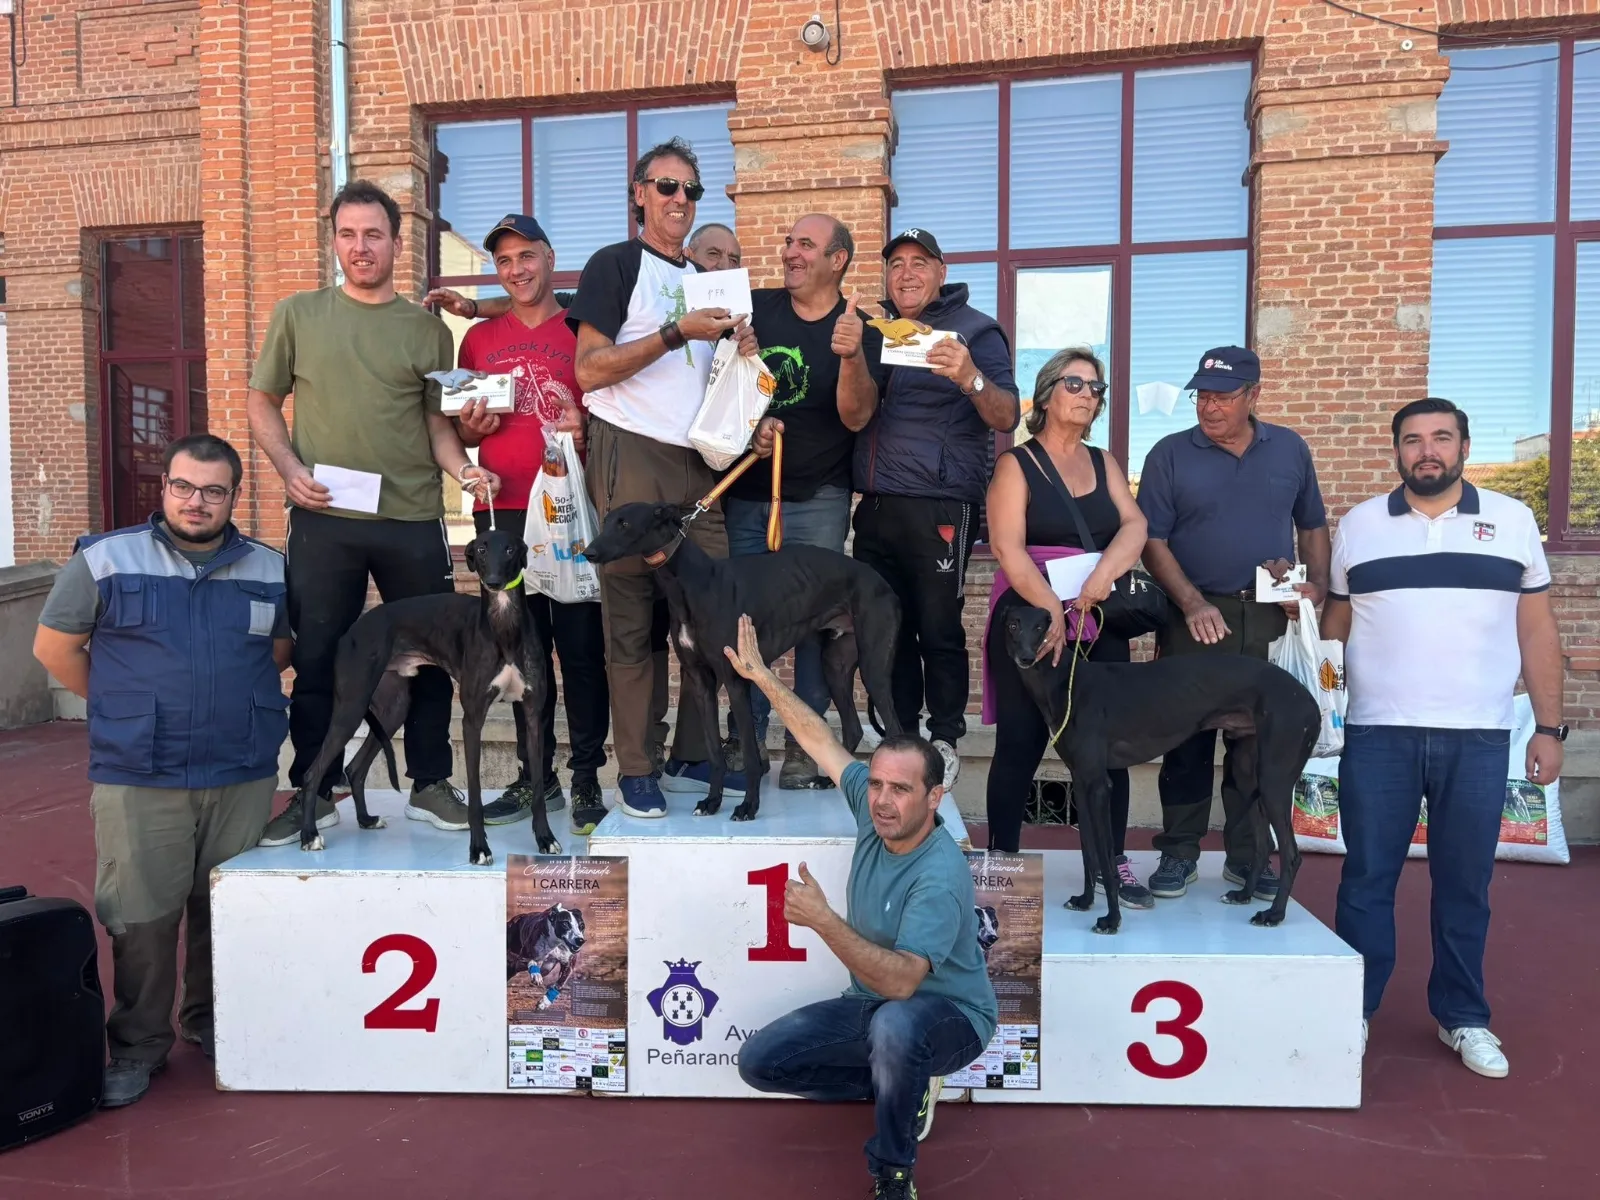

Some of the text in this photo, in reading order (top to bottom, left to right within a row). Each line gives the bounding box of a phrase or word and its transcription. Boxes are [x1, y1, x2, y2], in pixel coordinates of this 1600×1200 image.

[486, 341, 572, 364] Brooklyn
[523, 864, 559, 876] Ciudad
[566, 863, 611, 877] Peñaranda
[540, 878, 600, 890] CARRERA
[748, 863, 807, 961] 1
[362, 934, 440, 1032] 2
[725, 1025, 757, 1041] Ay
[1127, 980, 1207, 1079] 3
[20, 1104, 54, 1121] VONYX
